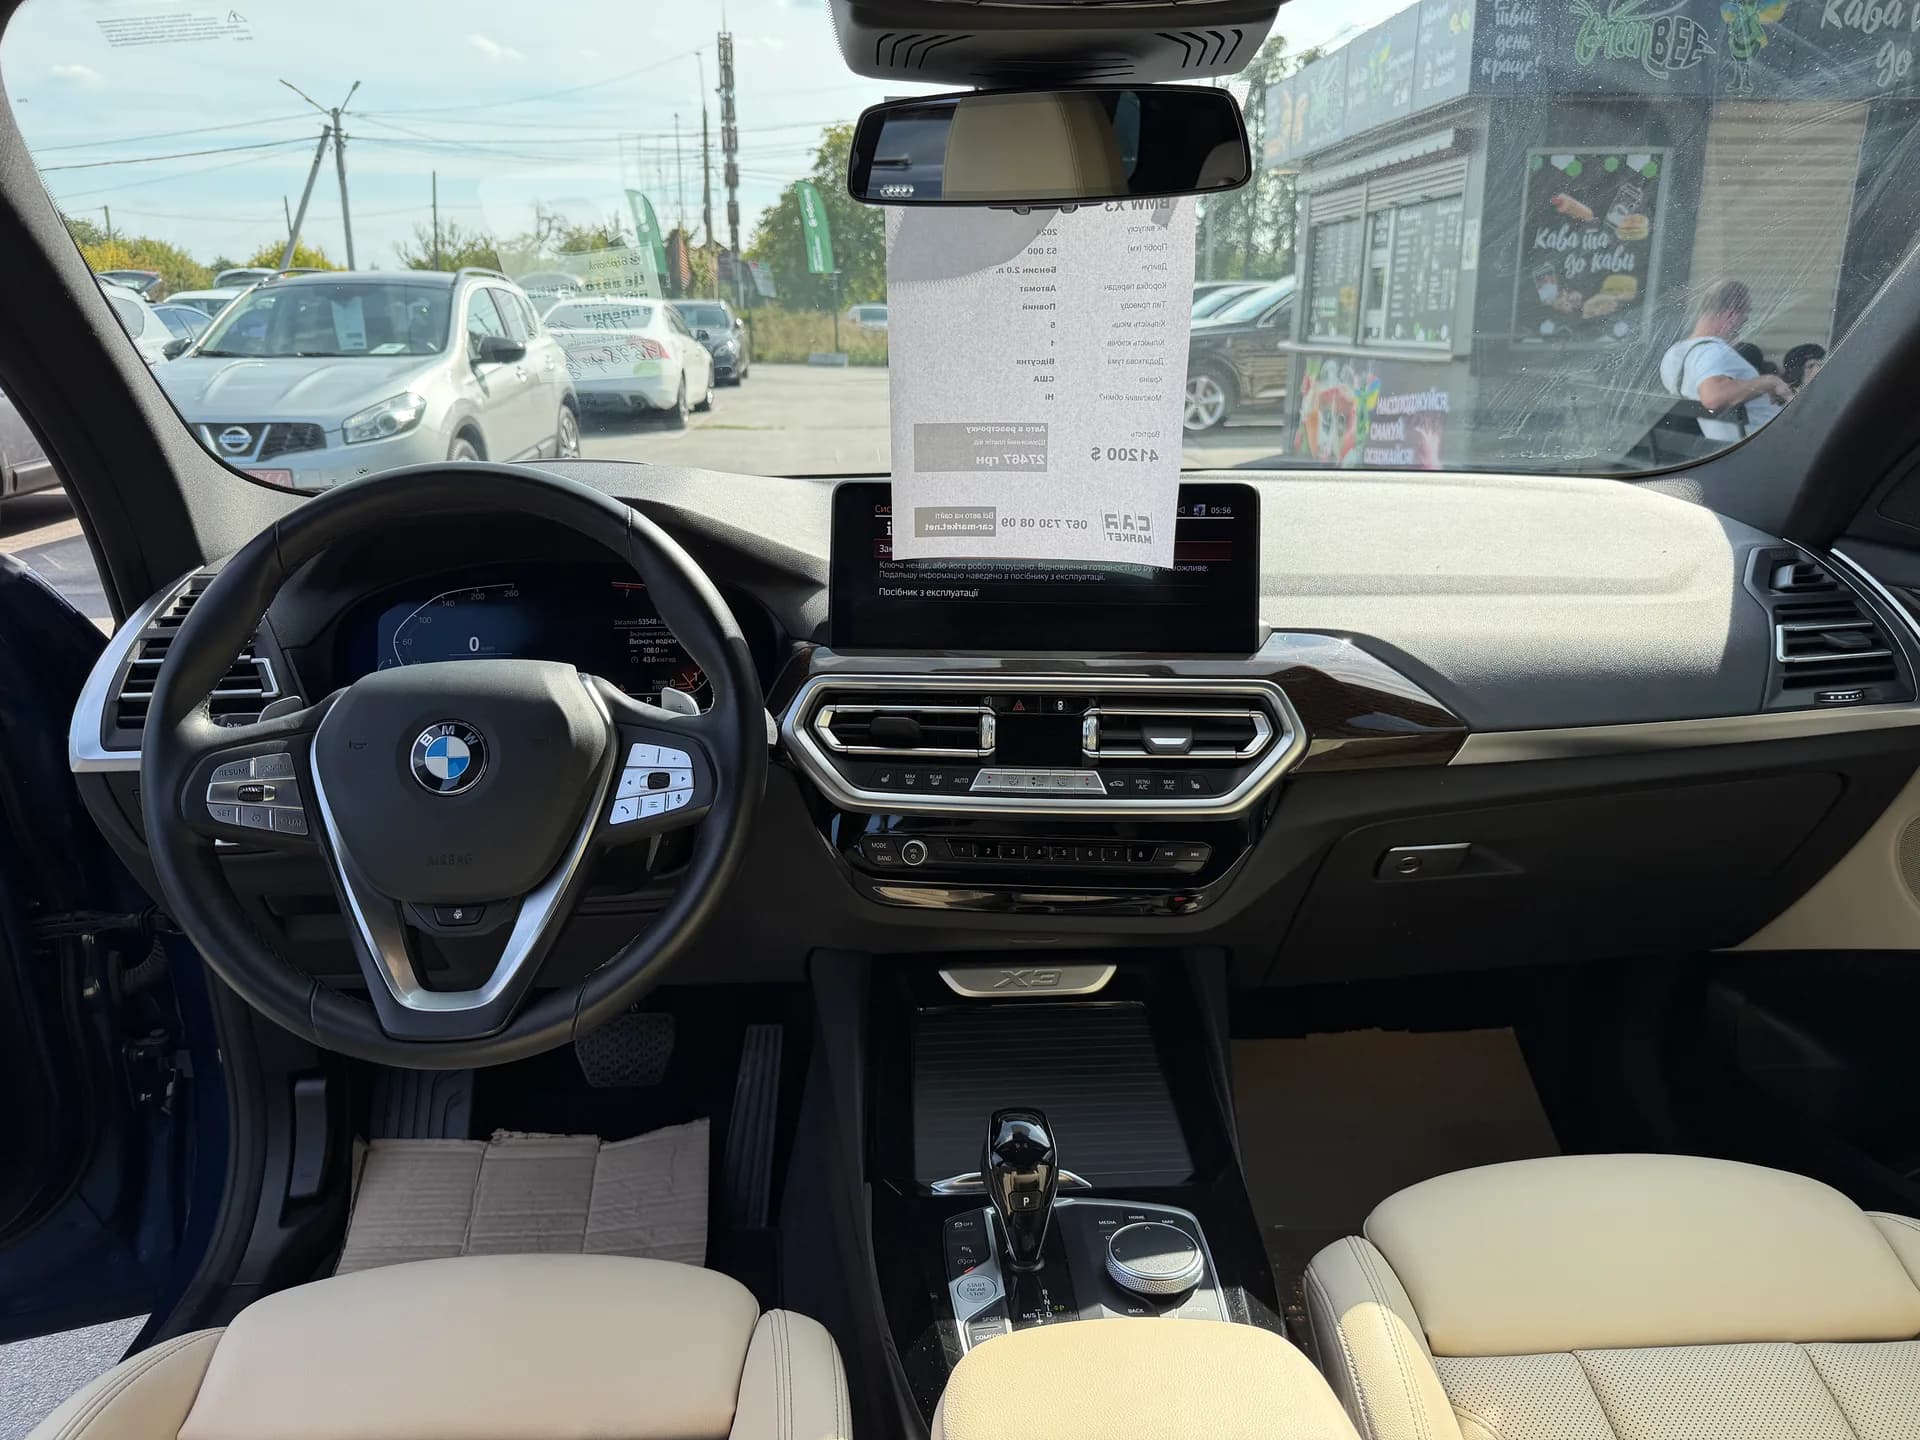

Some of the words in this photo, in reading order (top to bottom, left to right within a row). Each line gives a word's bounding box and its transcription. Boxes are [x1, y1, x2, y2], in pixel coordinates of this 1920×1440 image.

[1495, 34, 1530, 54] день
[1480, 56, 1541, 83] краще!
[1876, 40, 1912, 88] до
[1533, 224, 1578, 252] Кава
[1564, 253, 1586, 280] до
[1591, 245, 1635, 272] кави
[1210, 506, 1232, 514] 05:56
[879, 561, 904, 569] Ключа
[932, 561, 947, 569] або
[967, 561, 994, 571] роботу
[879, 571, 918, 579] Подальшу
[966, 572, 1003, 580] наведено
[1010, 572, 1050, 581] посібнику
[504, 590, 519, 598] 260
[625, 589, 630, 599] 7
[879, 588, 918, 597] Посібник
[919, 589, 924, 597] з
[926, 588, 980, 599] експлуатації
[441, 600, 455, 608] 140
[419, 616, 432, 624] 100
[402, 638, 413, 646] 60
[469, 636, 480, 652] 0
[420, 725, 479, 748] BMW
[216, 809, 231, 817] SET
[994, 969, 1063, 988] X3
[1022, 1196, 1030, 1207] P
